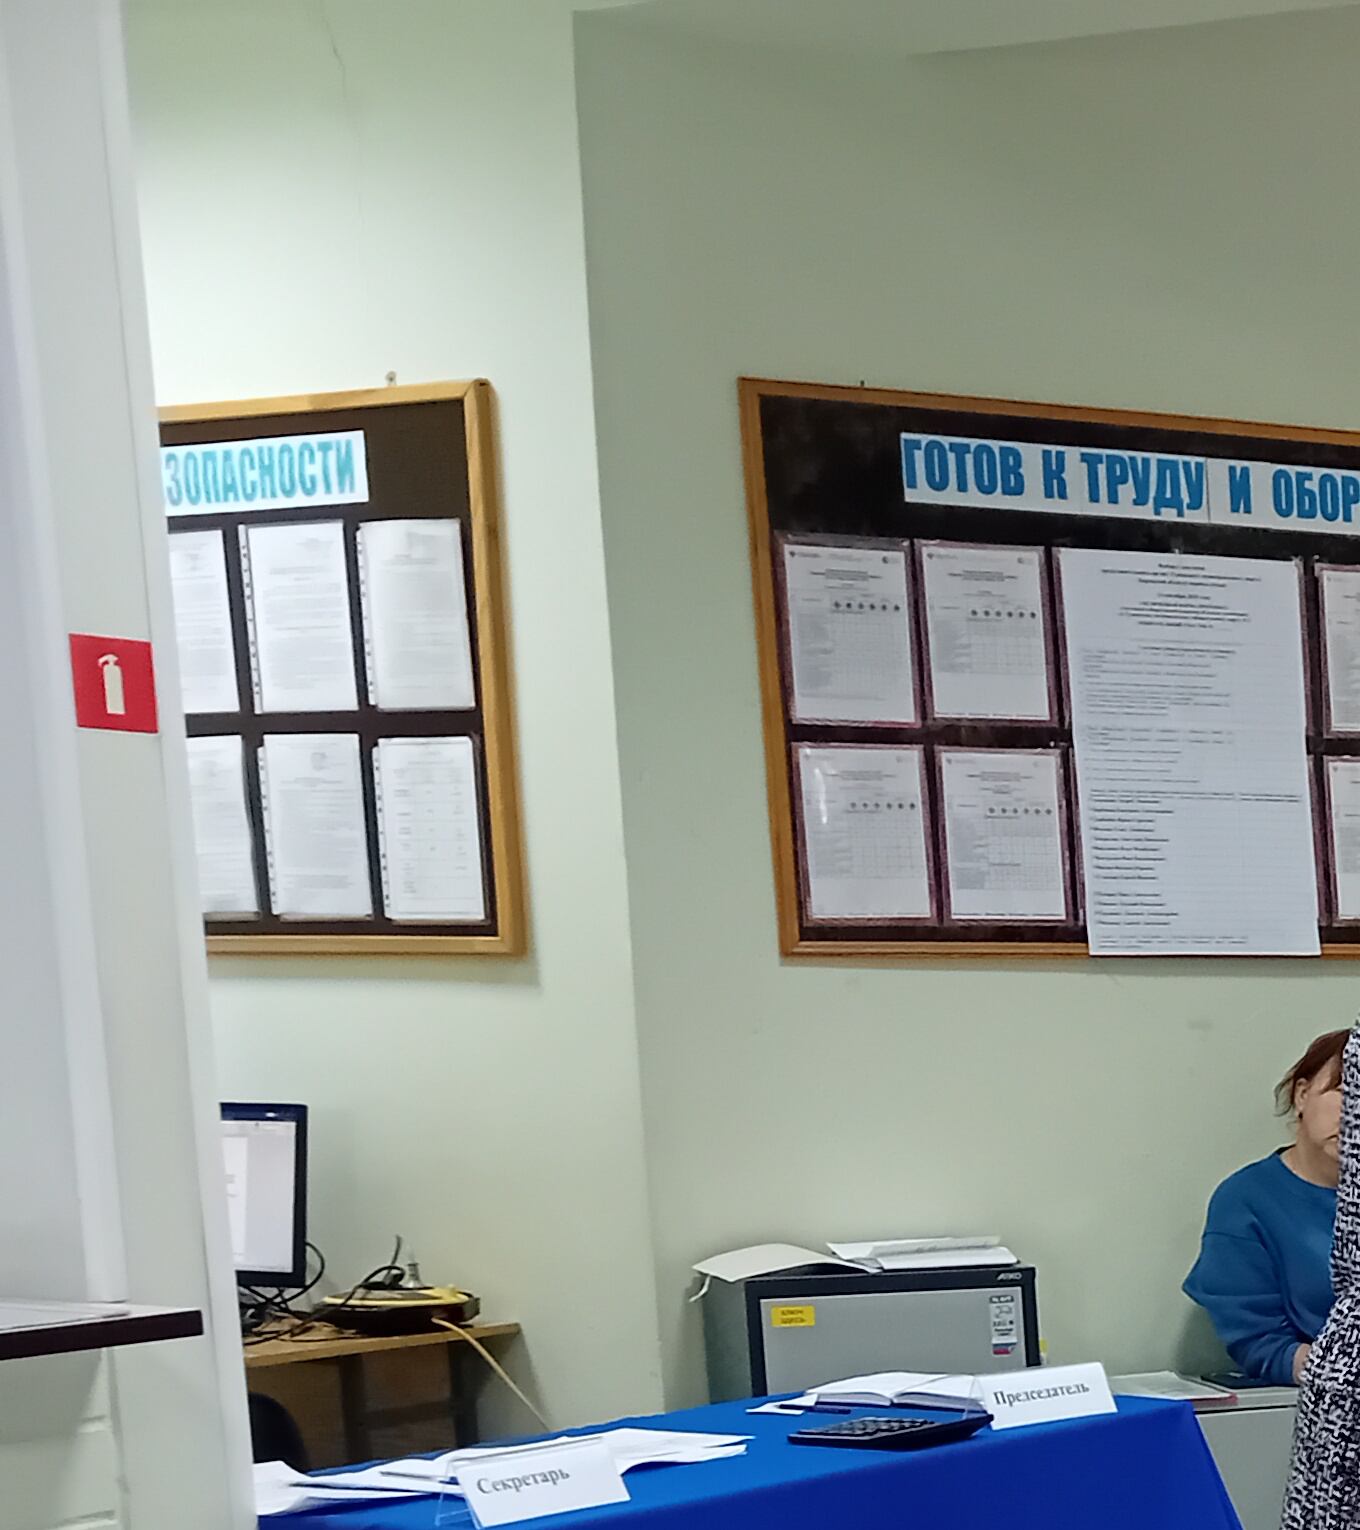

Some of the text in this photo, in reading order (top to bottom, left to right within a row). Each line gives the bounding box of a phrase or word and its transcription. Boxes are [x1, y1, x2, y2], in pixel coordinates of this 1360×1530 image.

[165, 439, 355, 506] ЗОПАСНОСТИ
[902, 438, 1024, 496] ГОТОВ
[1043, 449, 1068, 500] К
[1080, 452, 1205, 518] ТРУДУ
[1229, 465, 1252, 515] И
[993, 1383, 1090, 1407] Председатель
[477, 1468, 571, 1494] Секретарь
